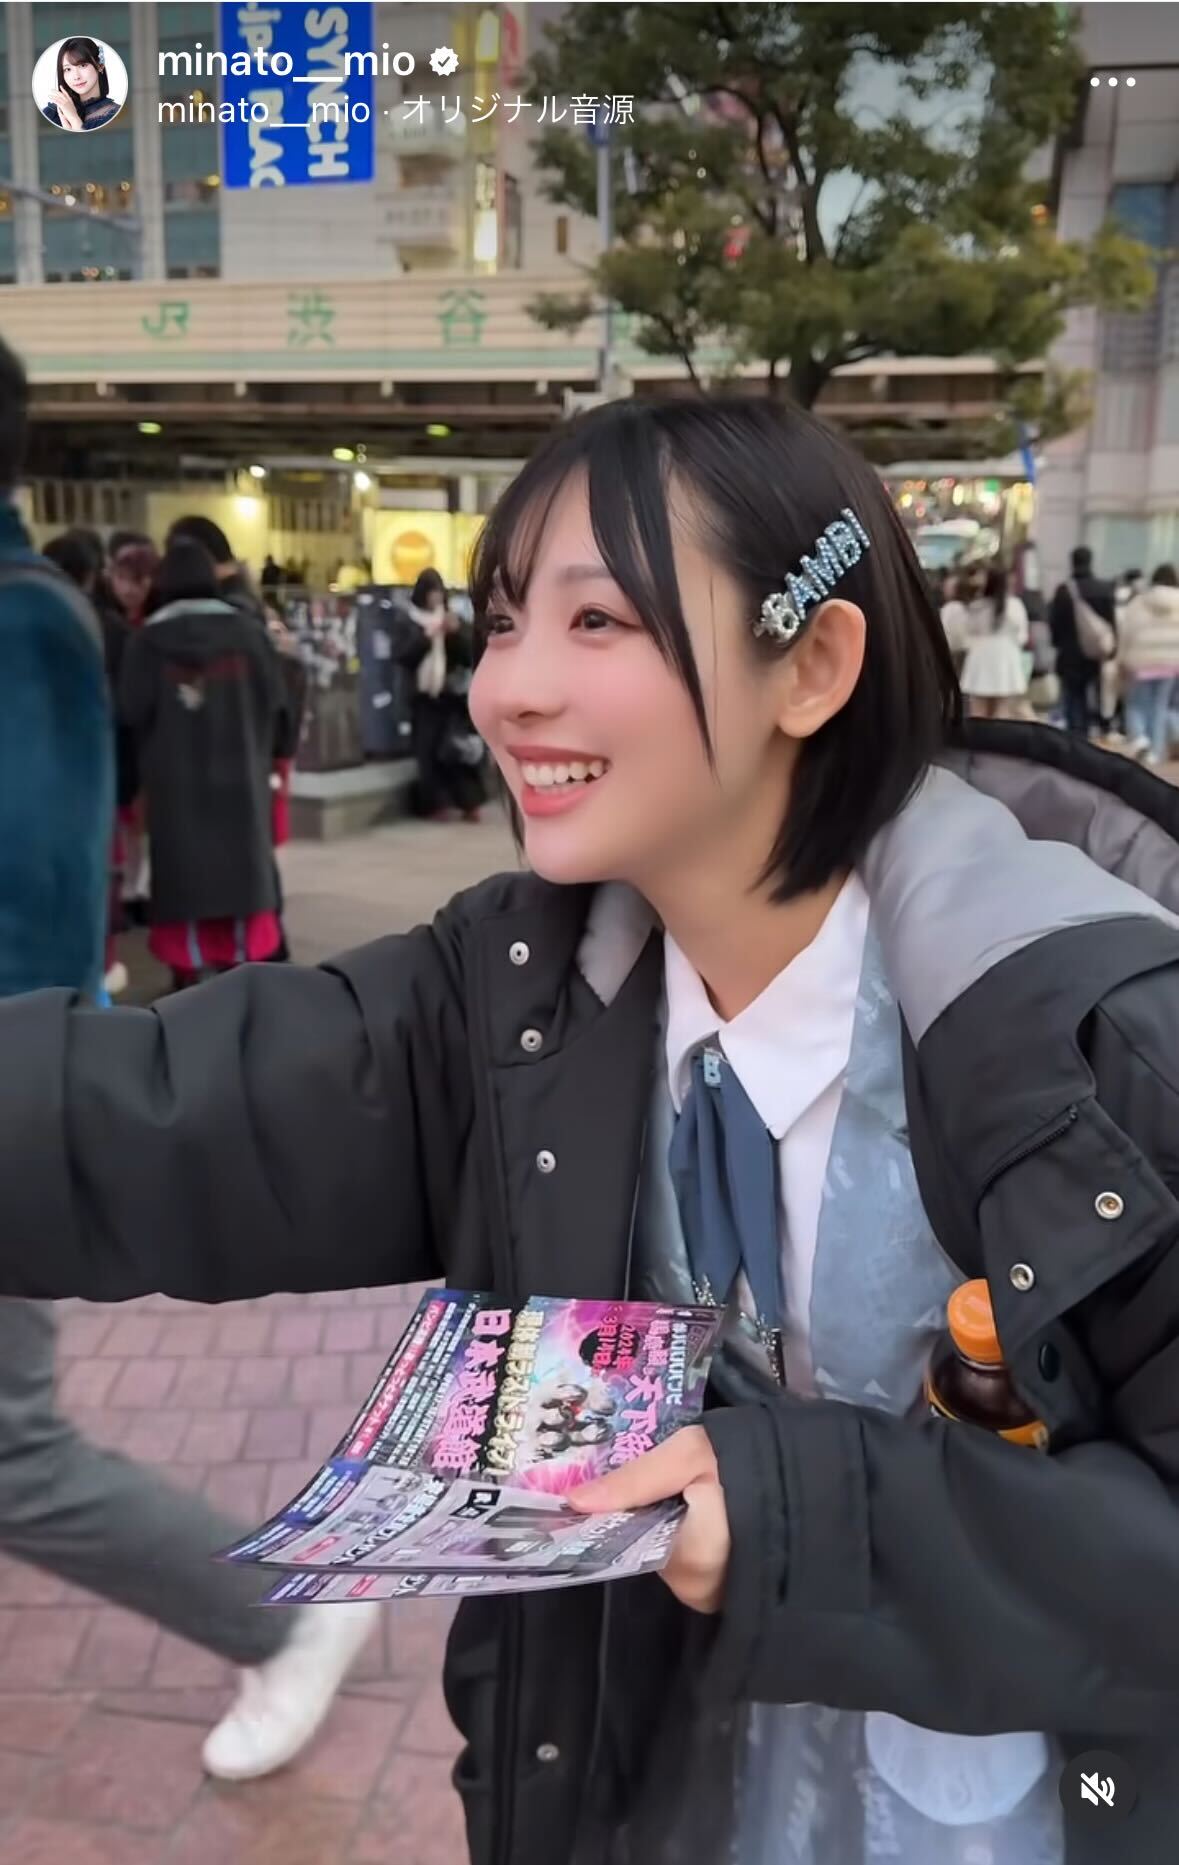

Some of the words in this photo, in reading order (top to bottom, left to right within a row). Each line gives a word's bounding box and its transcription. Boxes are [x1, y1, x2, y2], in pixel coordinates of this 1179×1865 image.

[304, 6, 349, 178] SYNCH
[141, 300, 190, 341] JR
[286, 286, 490, 347] 渋谷
[431, 1308, 512, 1472] 日本武道館
